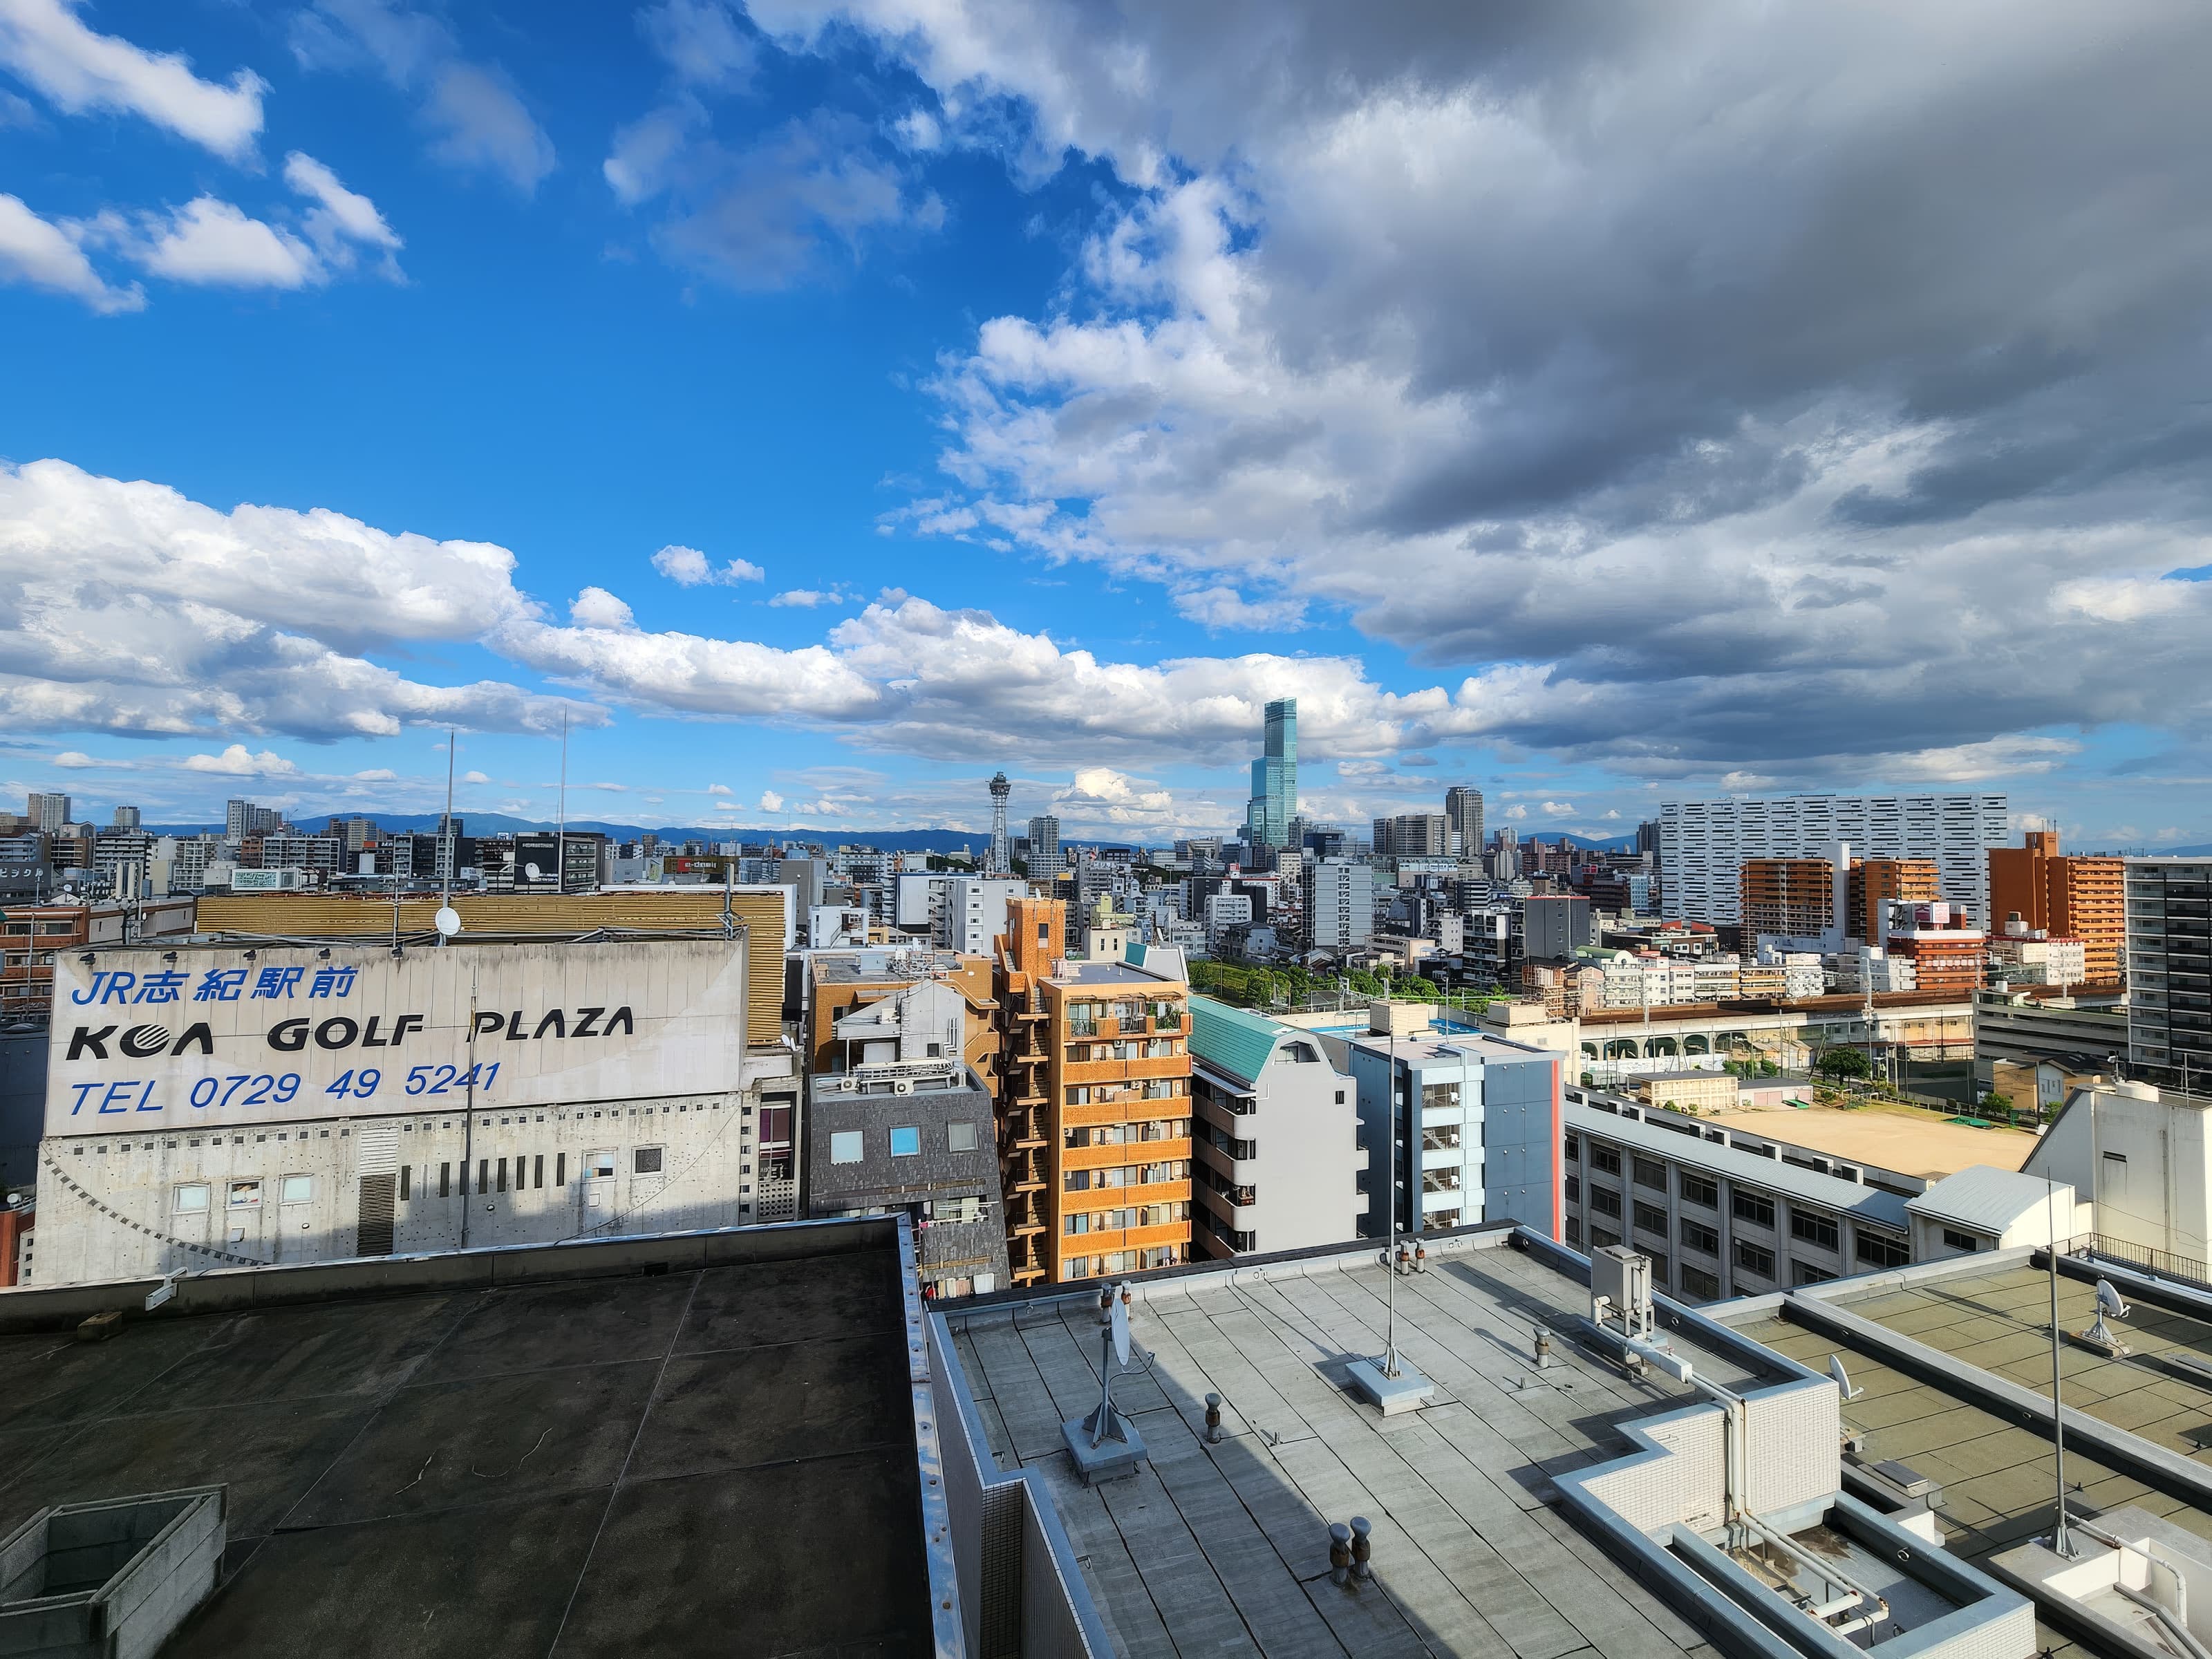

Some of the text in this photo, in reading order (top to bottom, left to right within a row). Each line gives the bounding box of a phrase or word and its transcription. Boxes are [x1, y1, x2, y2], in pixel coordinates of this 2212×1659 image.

[71, 966, 358, 1006] JR志紀駅前
[66, 1006, 633, 1060] KOA GOLF PLAZA
[71, 1062, 500, 1115] TEL 0729 49 5241
